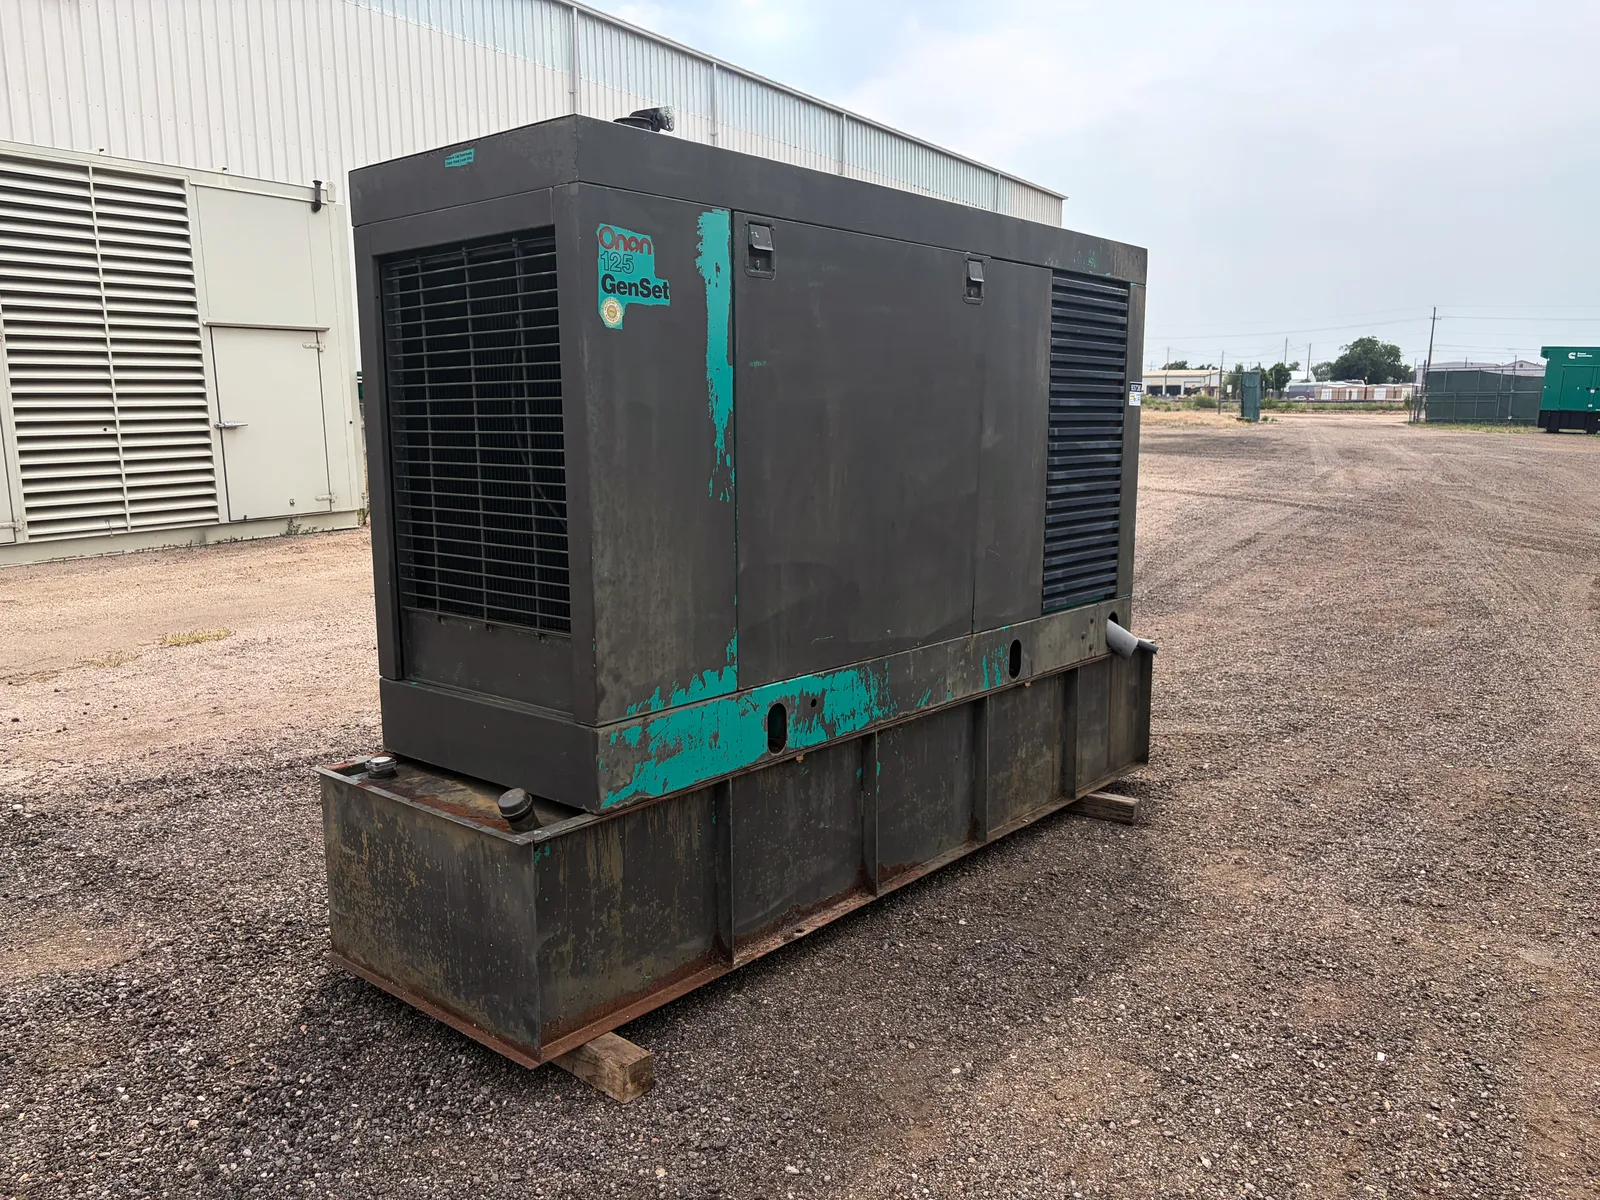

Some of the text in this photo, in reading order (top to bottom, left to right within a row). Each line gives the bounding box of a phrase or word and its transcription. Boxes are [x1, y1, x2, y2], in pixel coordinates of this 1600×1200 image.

[598, 226, 652, 255] Onan
[600, 250, 635, 274] 125
[601, 273, 670, 300] GenSet
